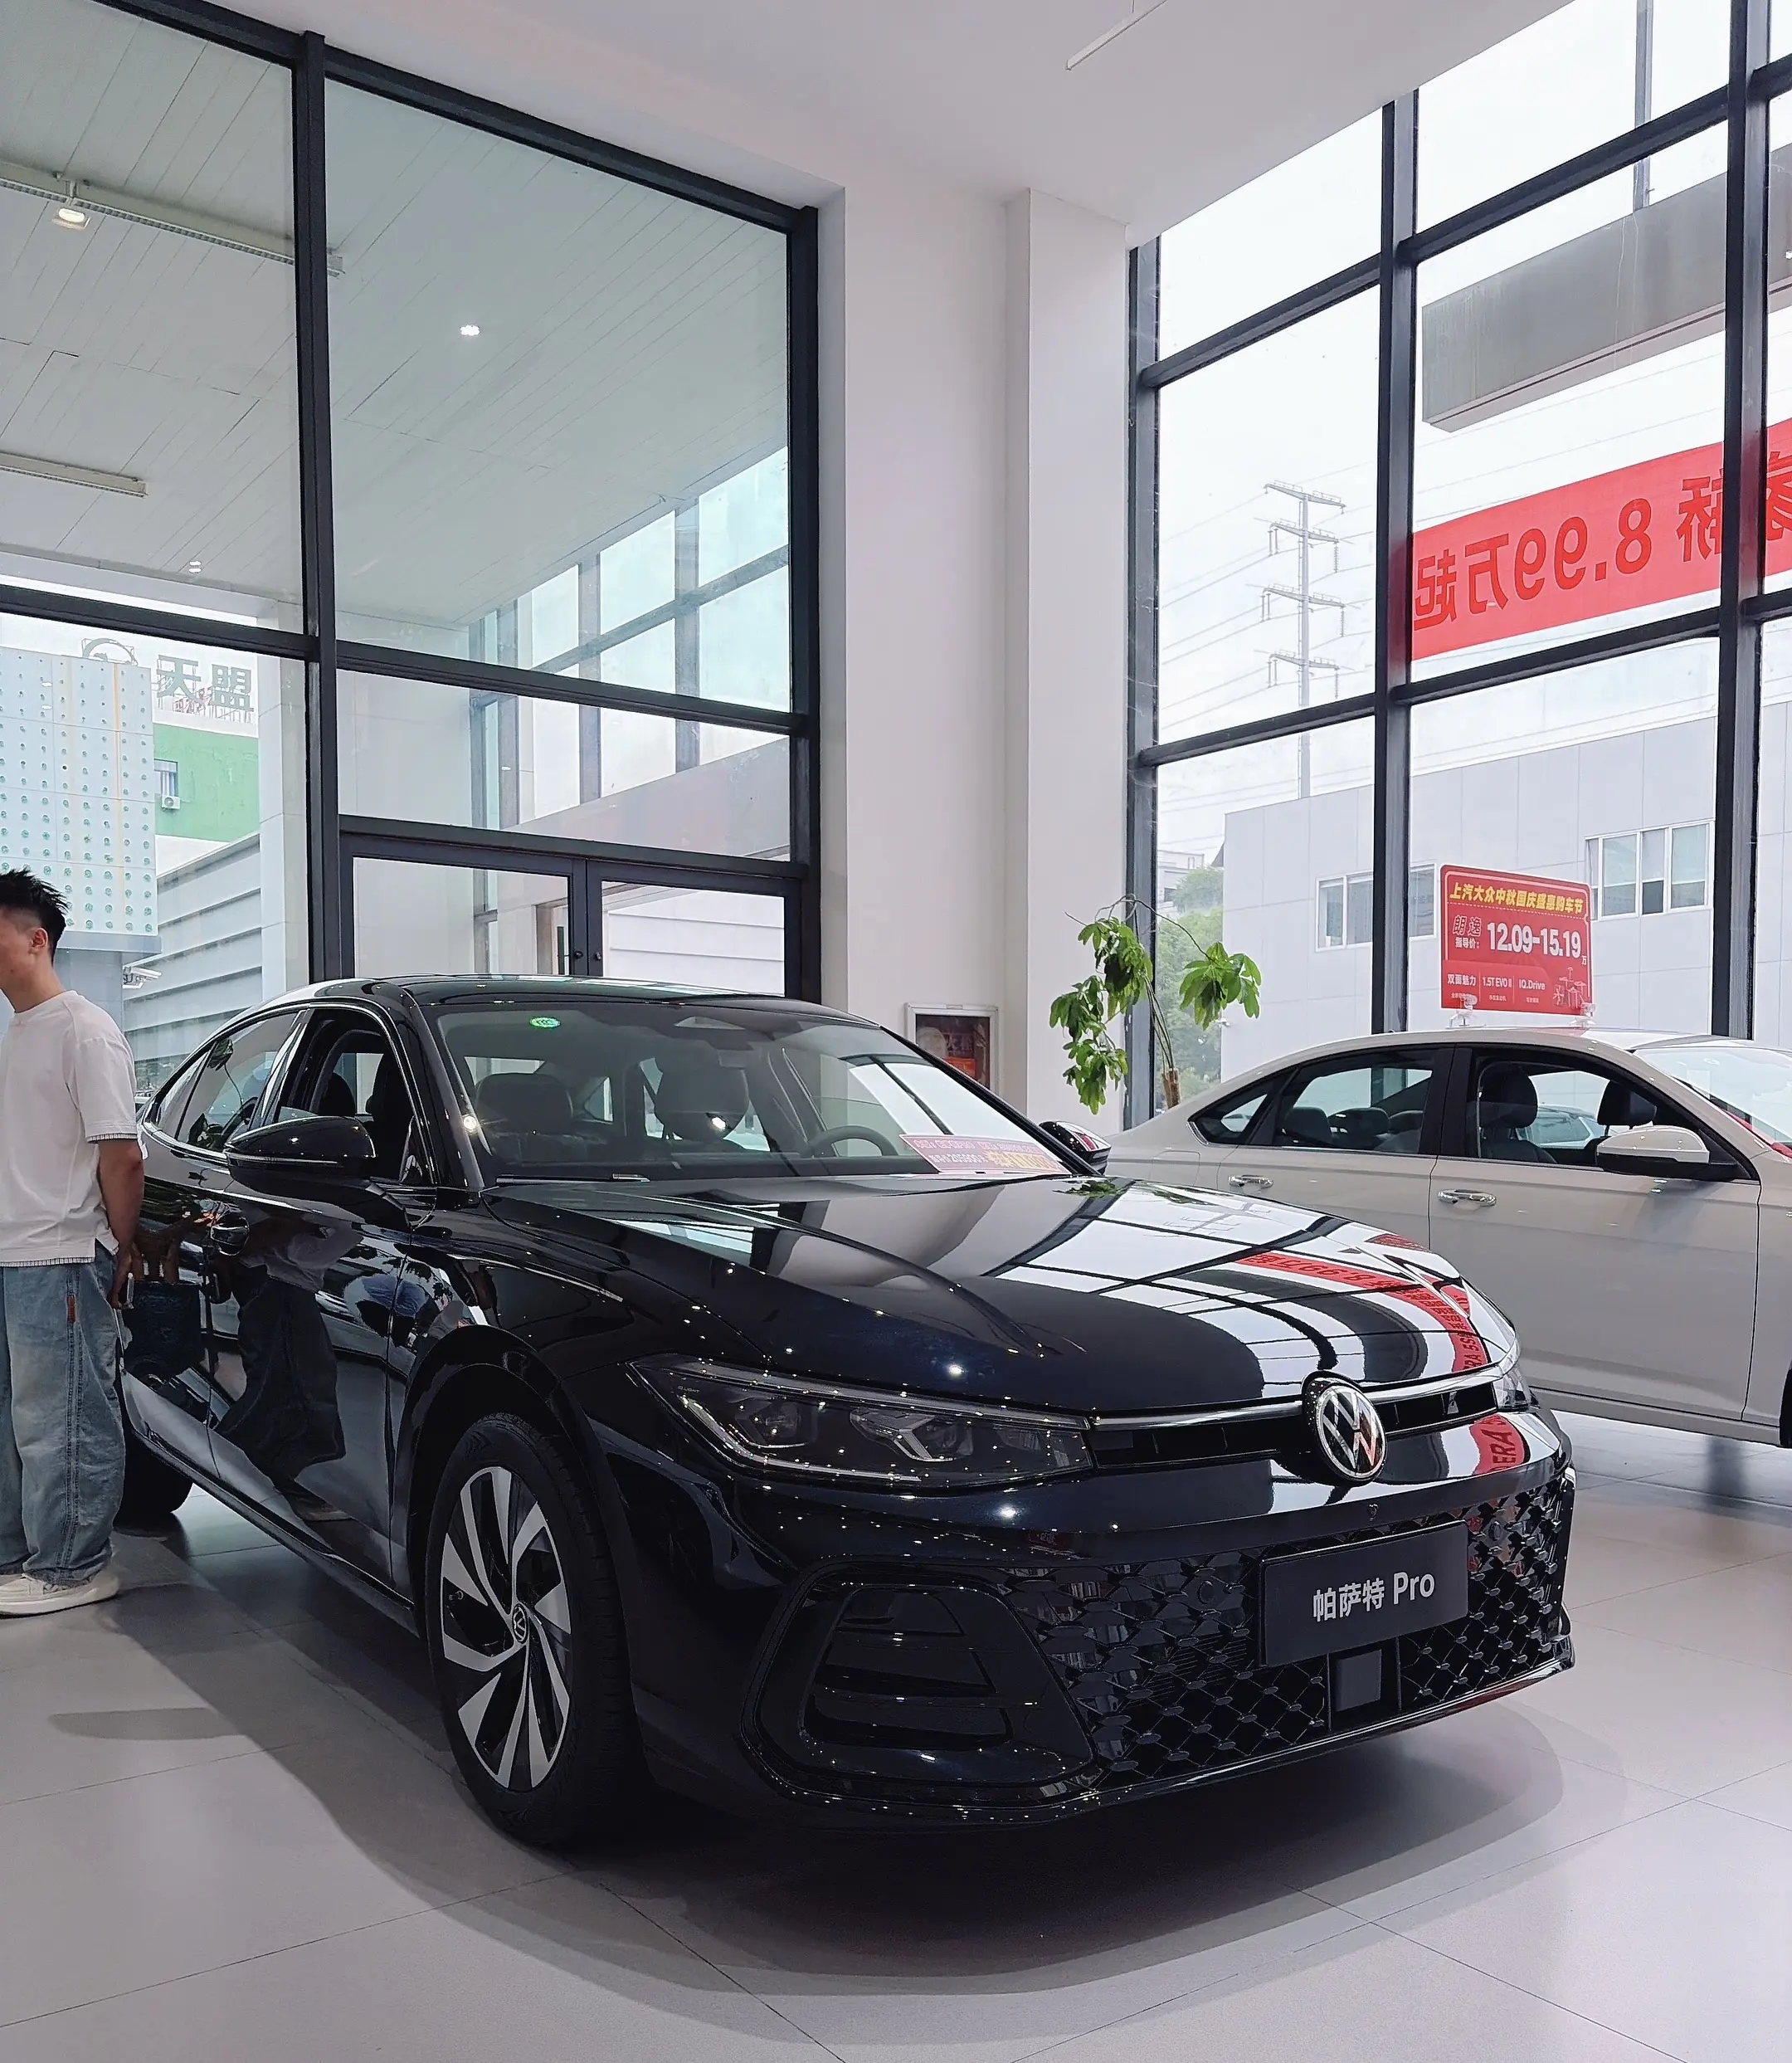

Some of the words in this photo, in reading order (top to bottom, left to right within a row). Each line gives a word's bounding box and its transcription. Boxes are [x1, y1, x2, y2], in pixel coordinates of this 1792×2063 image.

[157, 655, 254, 712] 天盟
[1450, 882, 1583, 914] 上汽大众中秋国庆盛惠购车节
[1488, 922, 1581, 958] 12.09-15.19
[1519, 979, 1546, 990] IQ.Drive
[1312, 1578, 1385, 1622] 帕萨特
[1393, 1572, 1434, 1605] Pro
